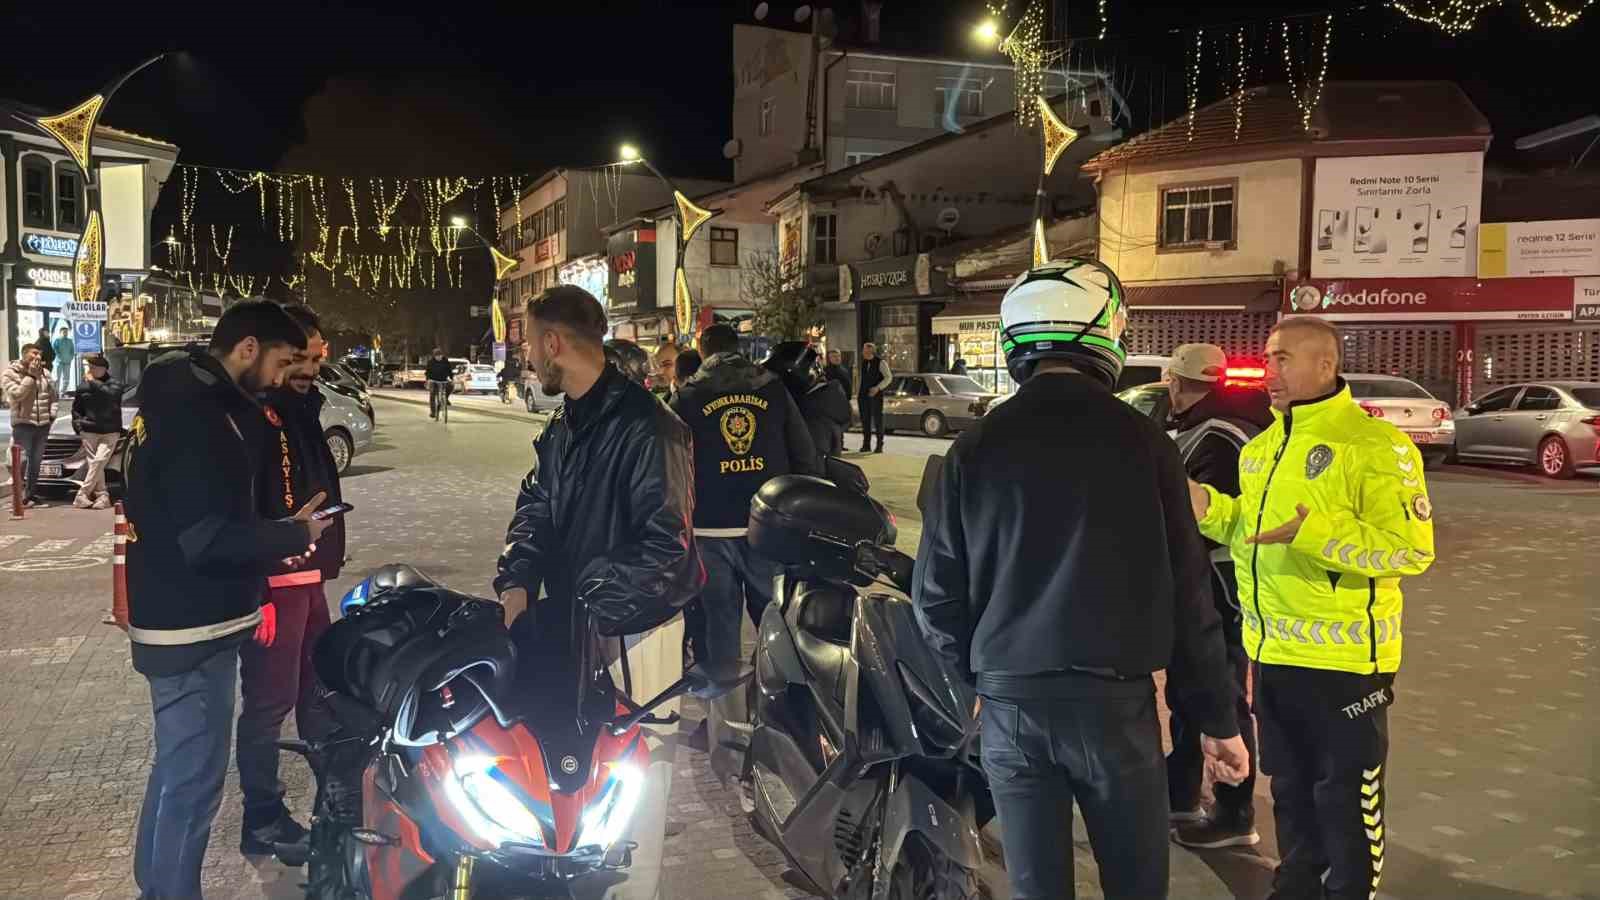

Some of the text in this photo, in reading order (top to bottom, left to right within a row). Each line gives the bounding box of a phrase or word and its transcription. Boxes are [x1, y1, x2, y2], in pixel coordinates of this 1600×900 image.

[1350, 174, 1440, 185] Redmi Note 10 Serisi
[1406, 185, 1431, 195] Zorla
[1516, 231, 1596, 243] realme 12 Serisi
[1329, 288, 1427, 306] vodafone
[1341, 688, 1388, 719] TRAFK
